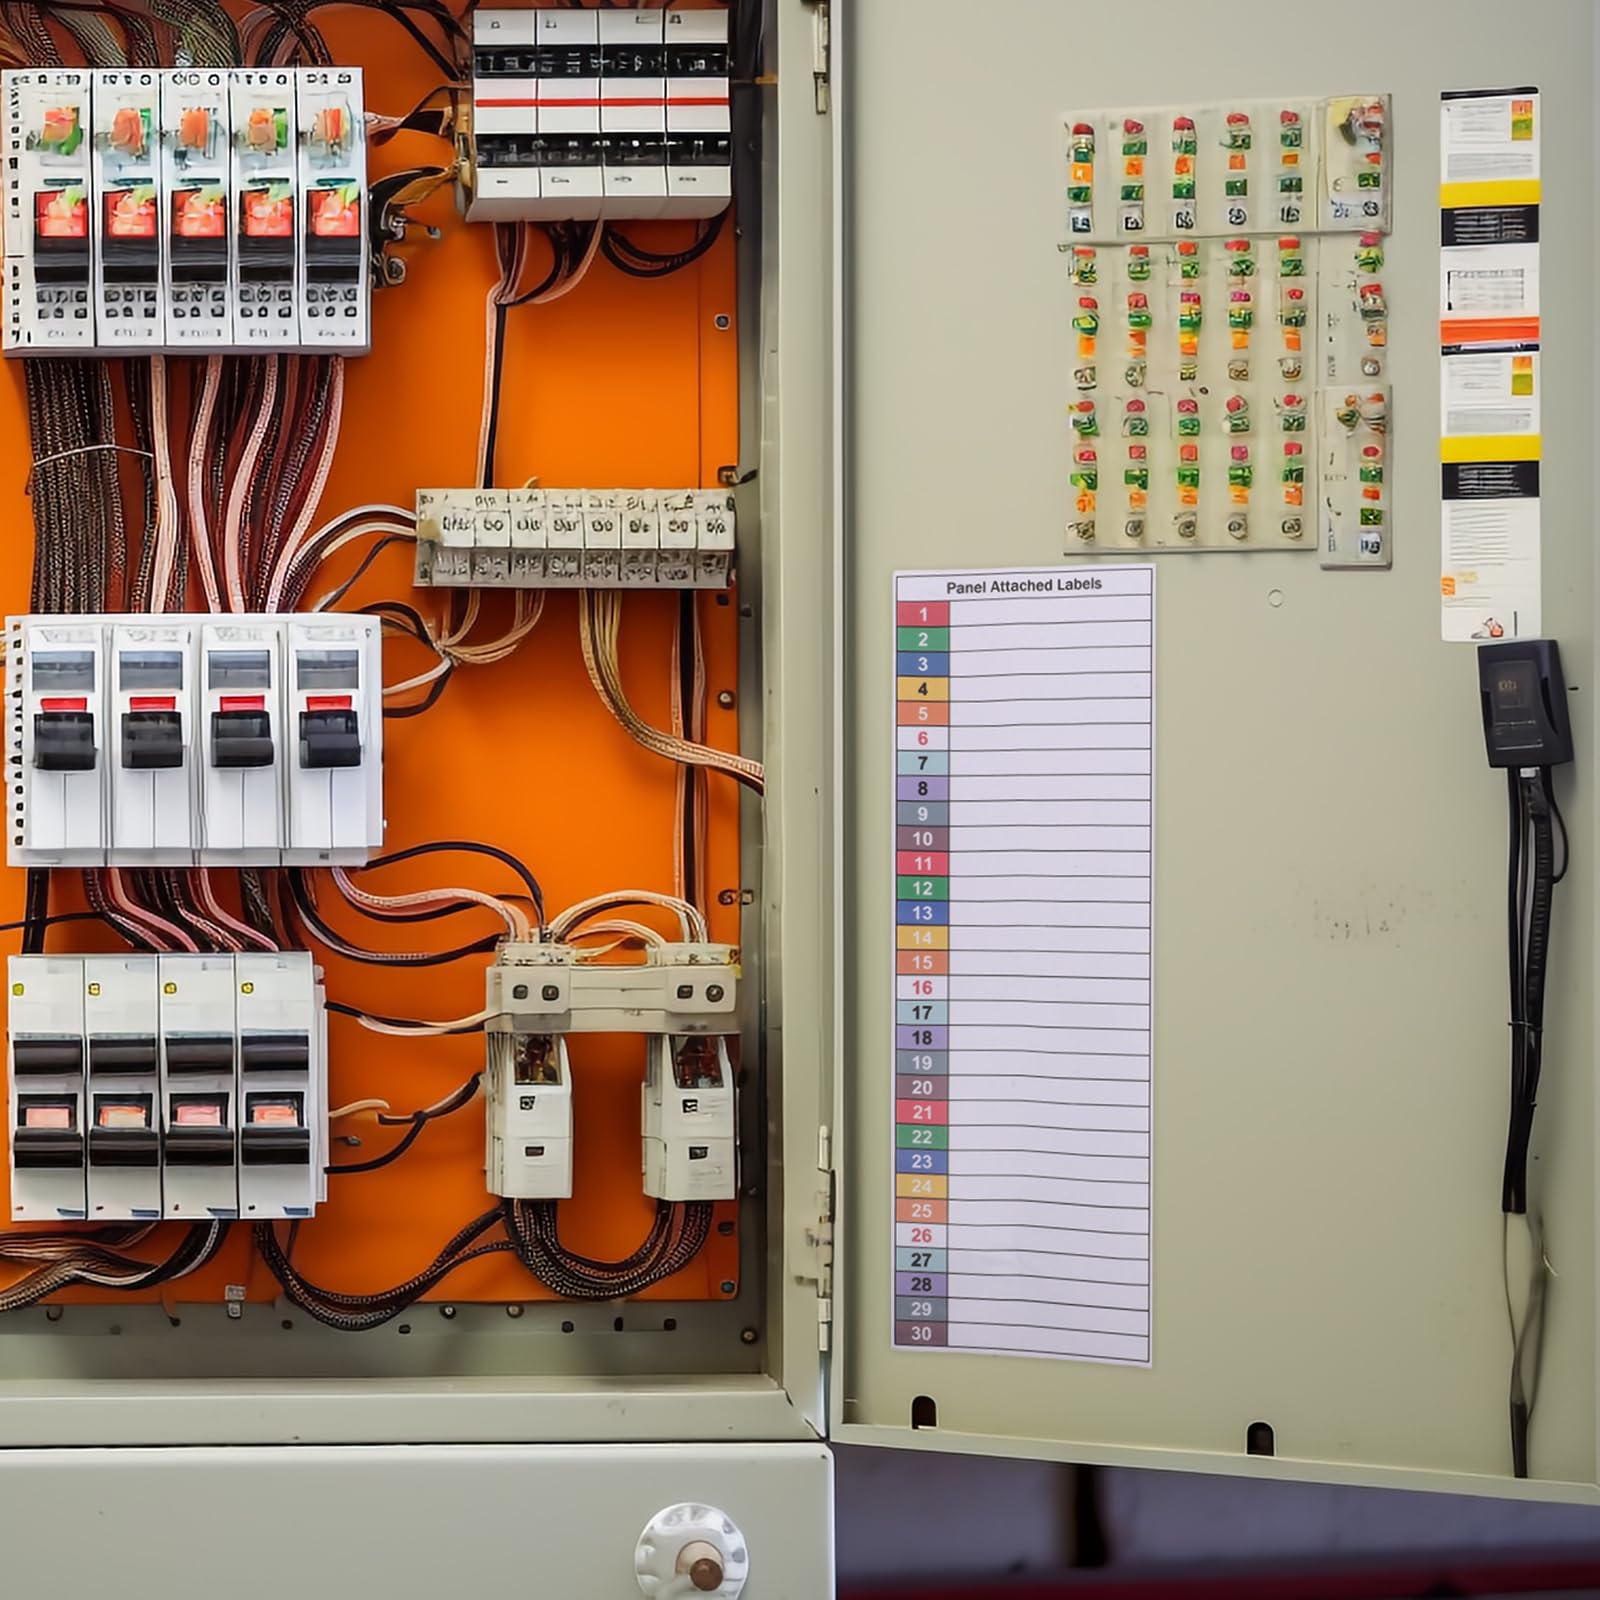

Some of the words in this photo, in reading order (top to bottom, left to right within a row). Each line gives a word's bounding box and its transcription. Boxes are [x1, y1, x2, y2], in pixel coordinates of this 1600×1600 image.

[947, 581, 986, 594] Panel
[990, 579, 1053, 592] Attached
[1057, 577, 1102, 590] Labels
[919, 606, 928, 621] 1
[919, 632, 928, 646] 2
[919, 657, 928, 671] 3
[918, 682, 928, 696] 4
[919, 707, 928, 720] 5
[918, 732, 928, 745] 6
[918, 756, 928, 770] 7
[918, 781, 928, 796] 8
[918, 807, 928, 821] 9
[912, 832, 932, 846] 10
[914, 857, 932, 871] 11
[912, 881, 932, 895] 12
[912, 906, 932, 920] 13
[912, 931, 931, 944] 14
[912, 956, 932, 969] 15
[912, 980, 932, 994] 16
[912, 1006, 932, 1020] 17
[912, 1031, 932, 1045] 18
[912, 1056, 932, 1070] 19
[911, 1080, 932, 1094] 20
[912, 1105, 932, 1119] 21
[911, 1130, 932, 1144] 22
[911, 1154, 932, 1168] 23
[911, 1179, 931, 1192] 24
[911, 1204, 932, 1217] 25
[911, 1228, 931, 1243] 26
[911, 1253, 931, 1267] 27
[911, 1277, 931, 1291] 28
[911, 1302, 931, 1316] 29
[911, 1326, 931, 1340] 30
